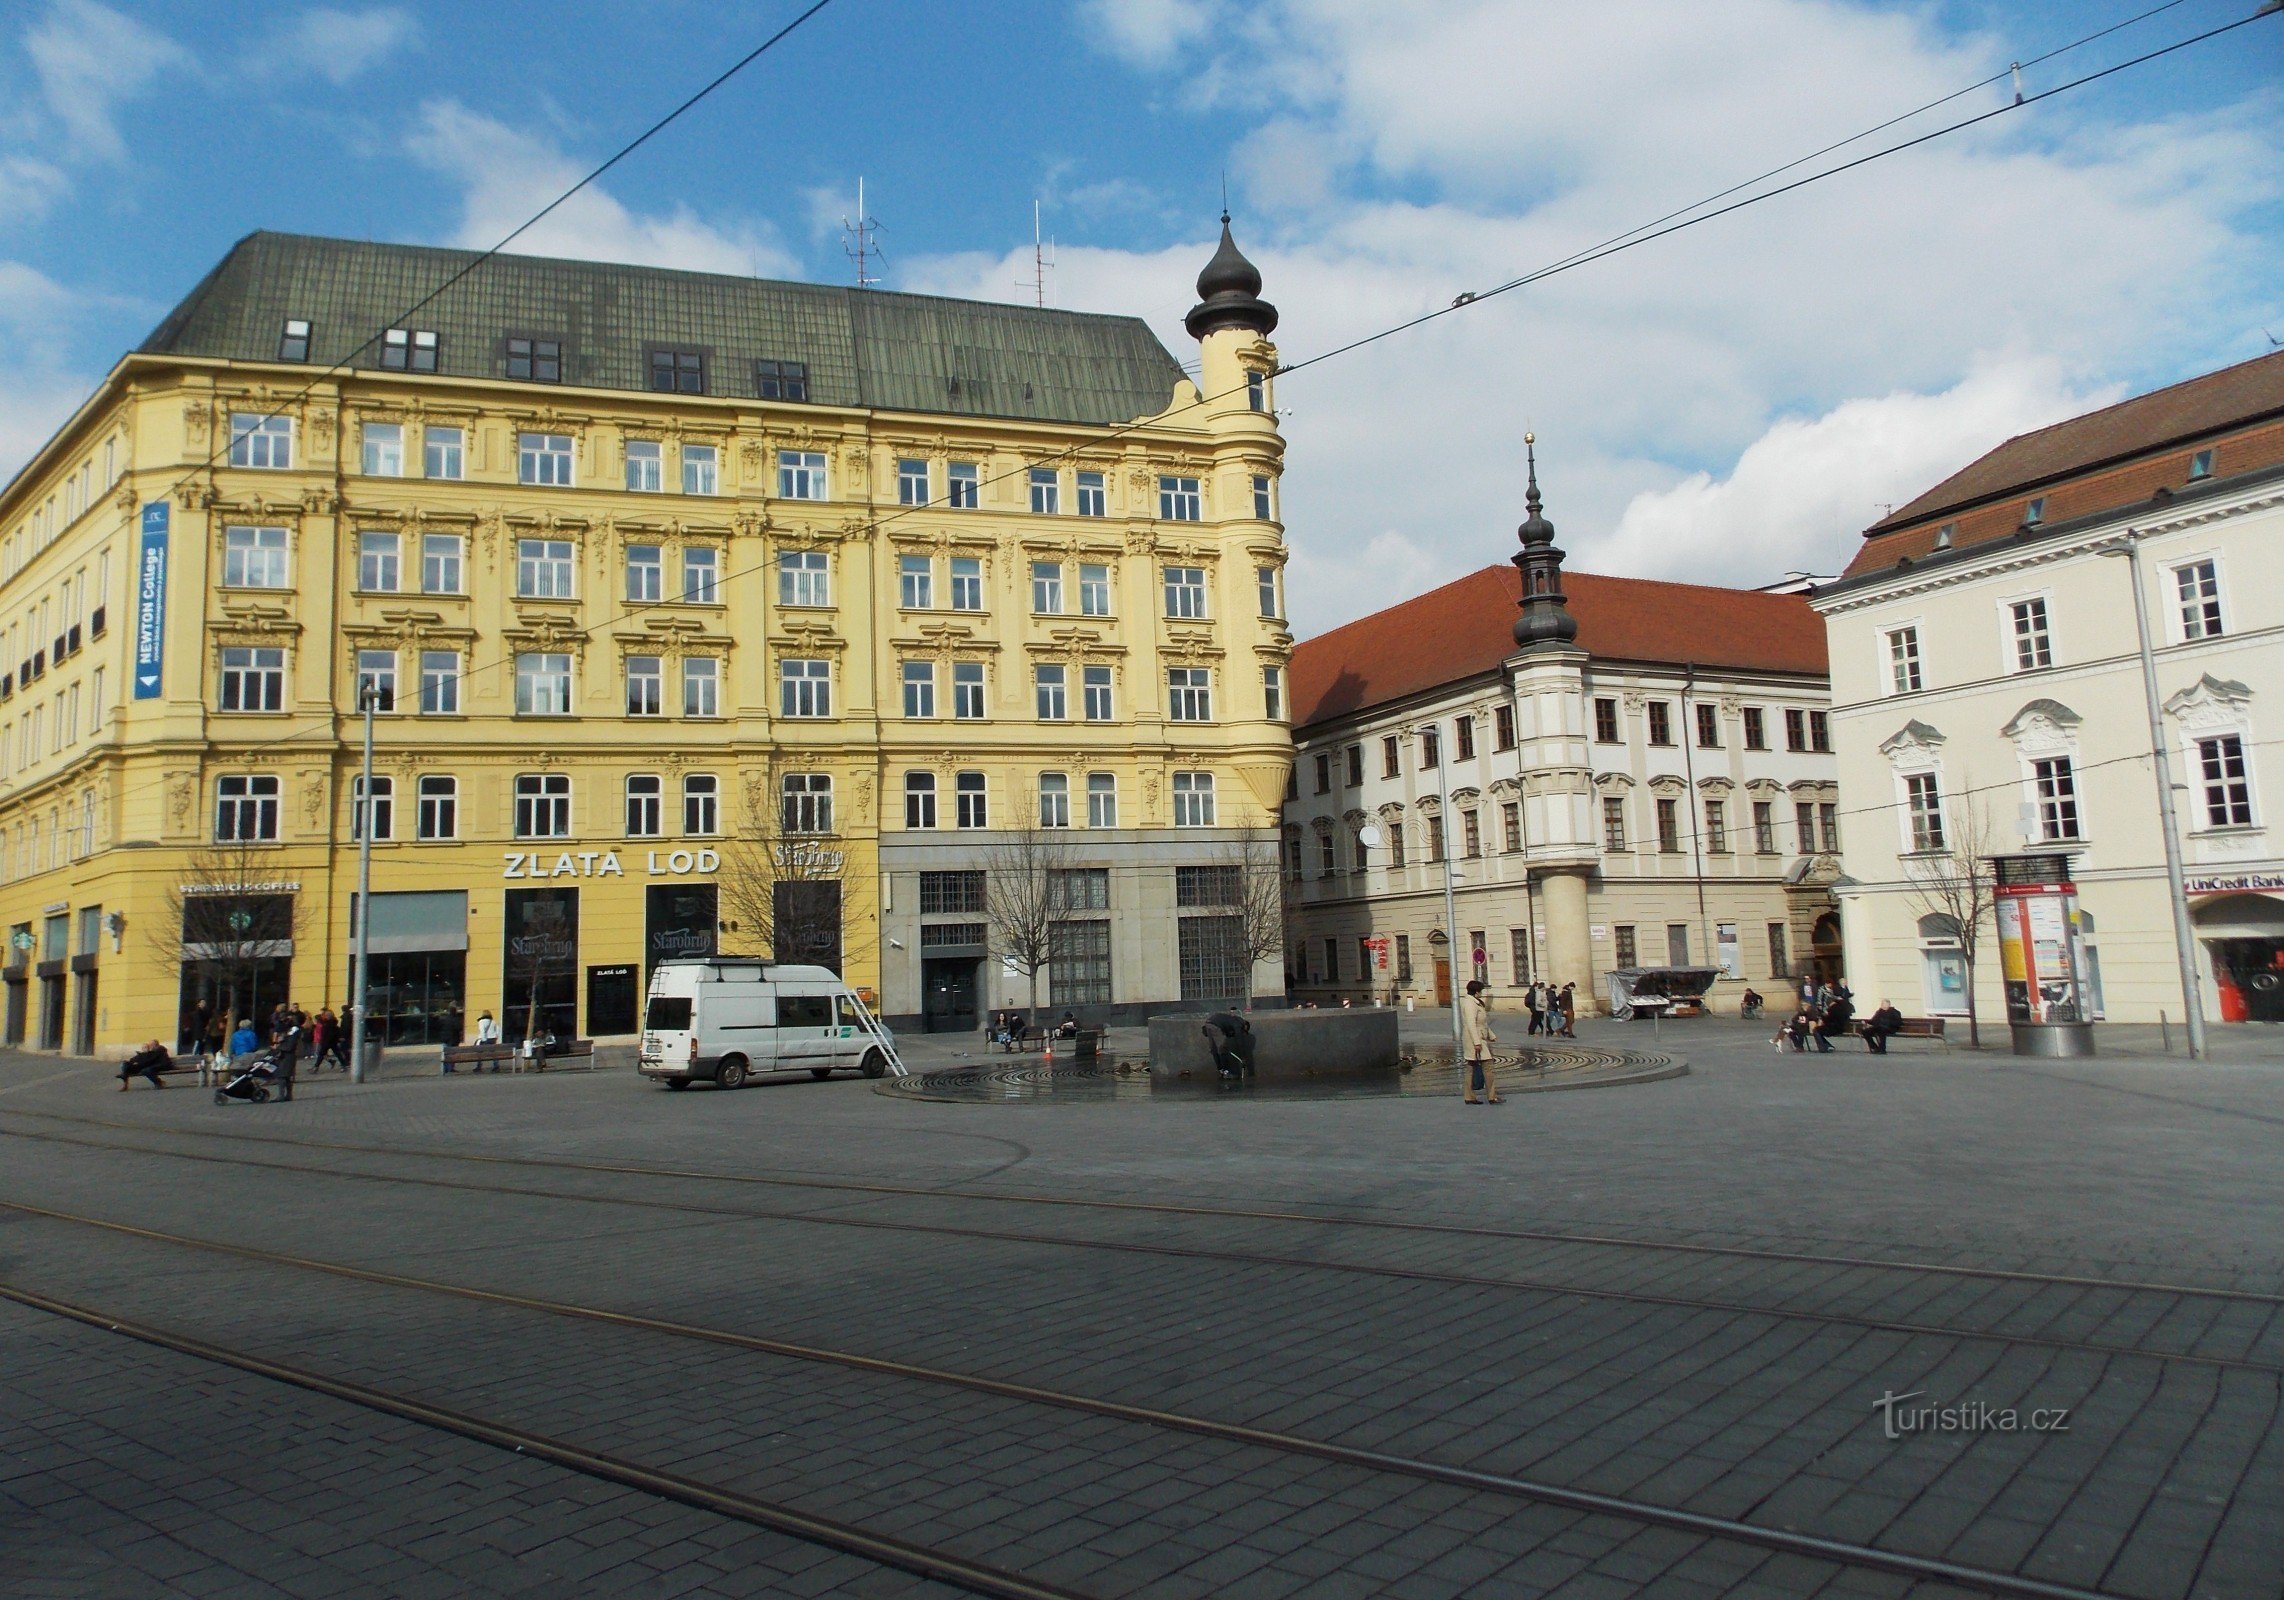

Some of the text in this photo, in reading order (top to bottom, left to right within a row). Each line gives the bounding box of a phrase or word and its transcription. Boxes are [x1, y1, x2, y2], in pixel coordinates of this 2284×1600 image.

[139, 547, 158, 664] NEWTON College
[254, 881, 300, 891] COFFEE
[2192, 874, 2284, 890] UniCredit Bank
[653, 928, 711, 956] Starobrno
